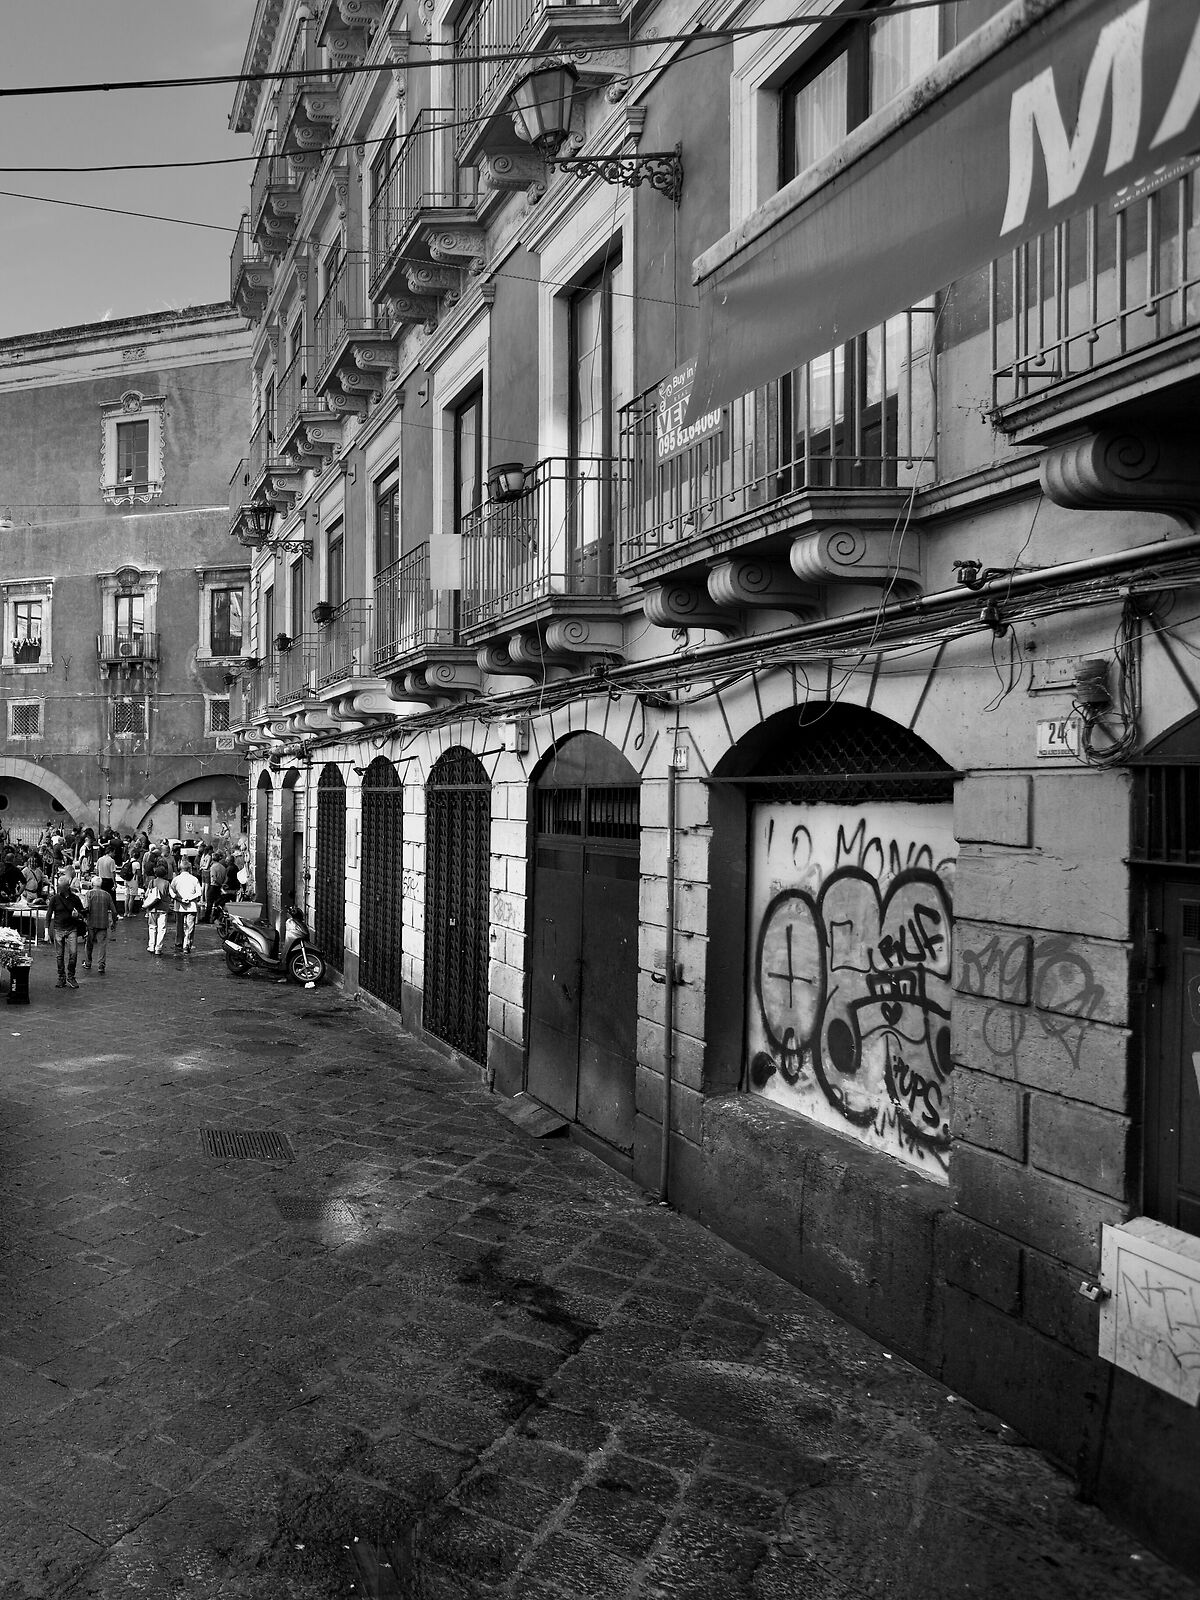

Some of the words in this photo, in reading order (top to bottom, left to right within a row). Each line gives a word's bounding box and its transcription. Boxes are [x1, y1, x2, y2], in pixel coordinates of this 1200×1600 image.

[672, 372, 686, 389] Buy
[686, 366, 695, 379] in
[658, 431, 676, 457] 095
[1049, 722, 1065, 744] 24
